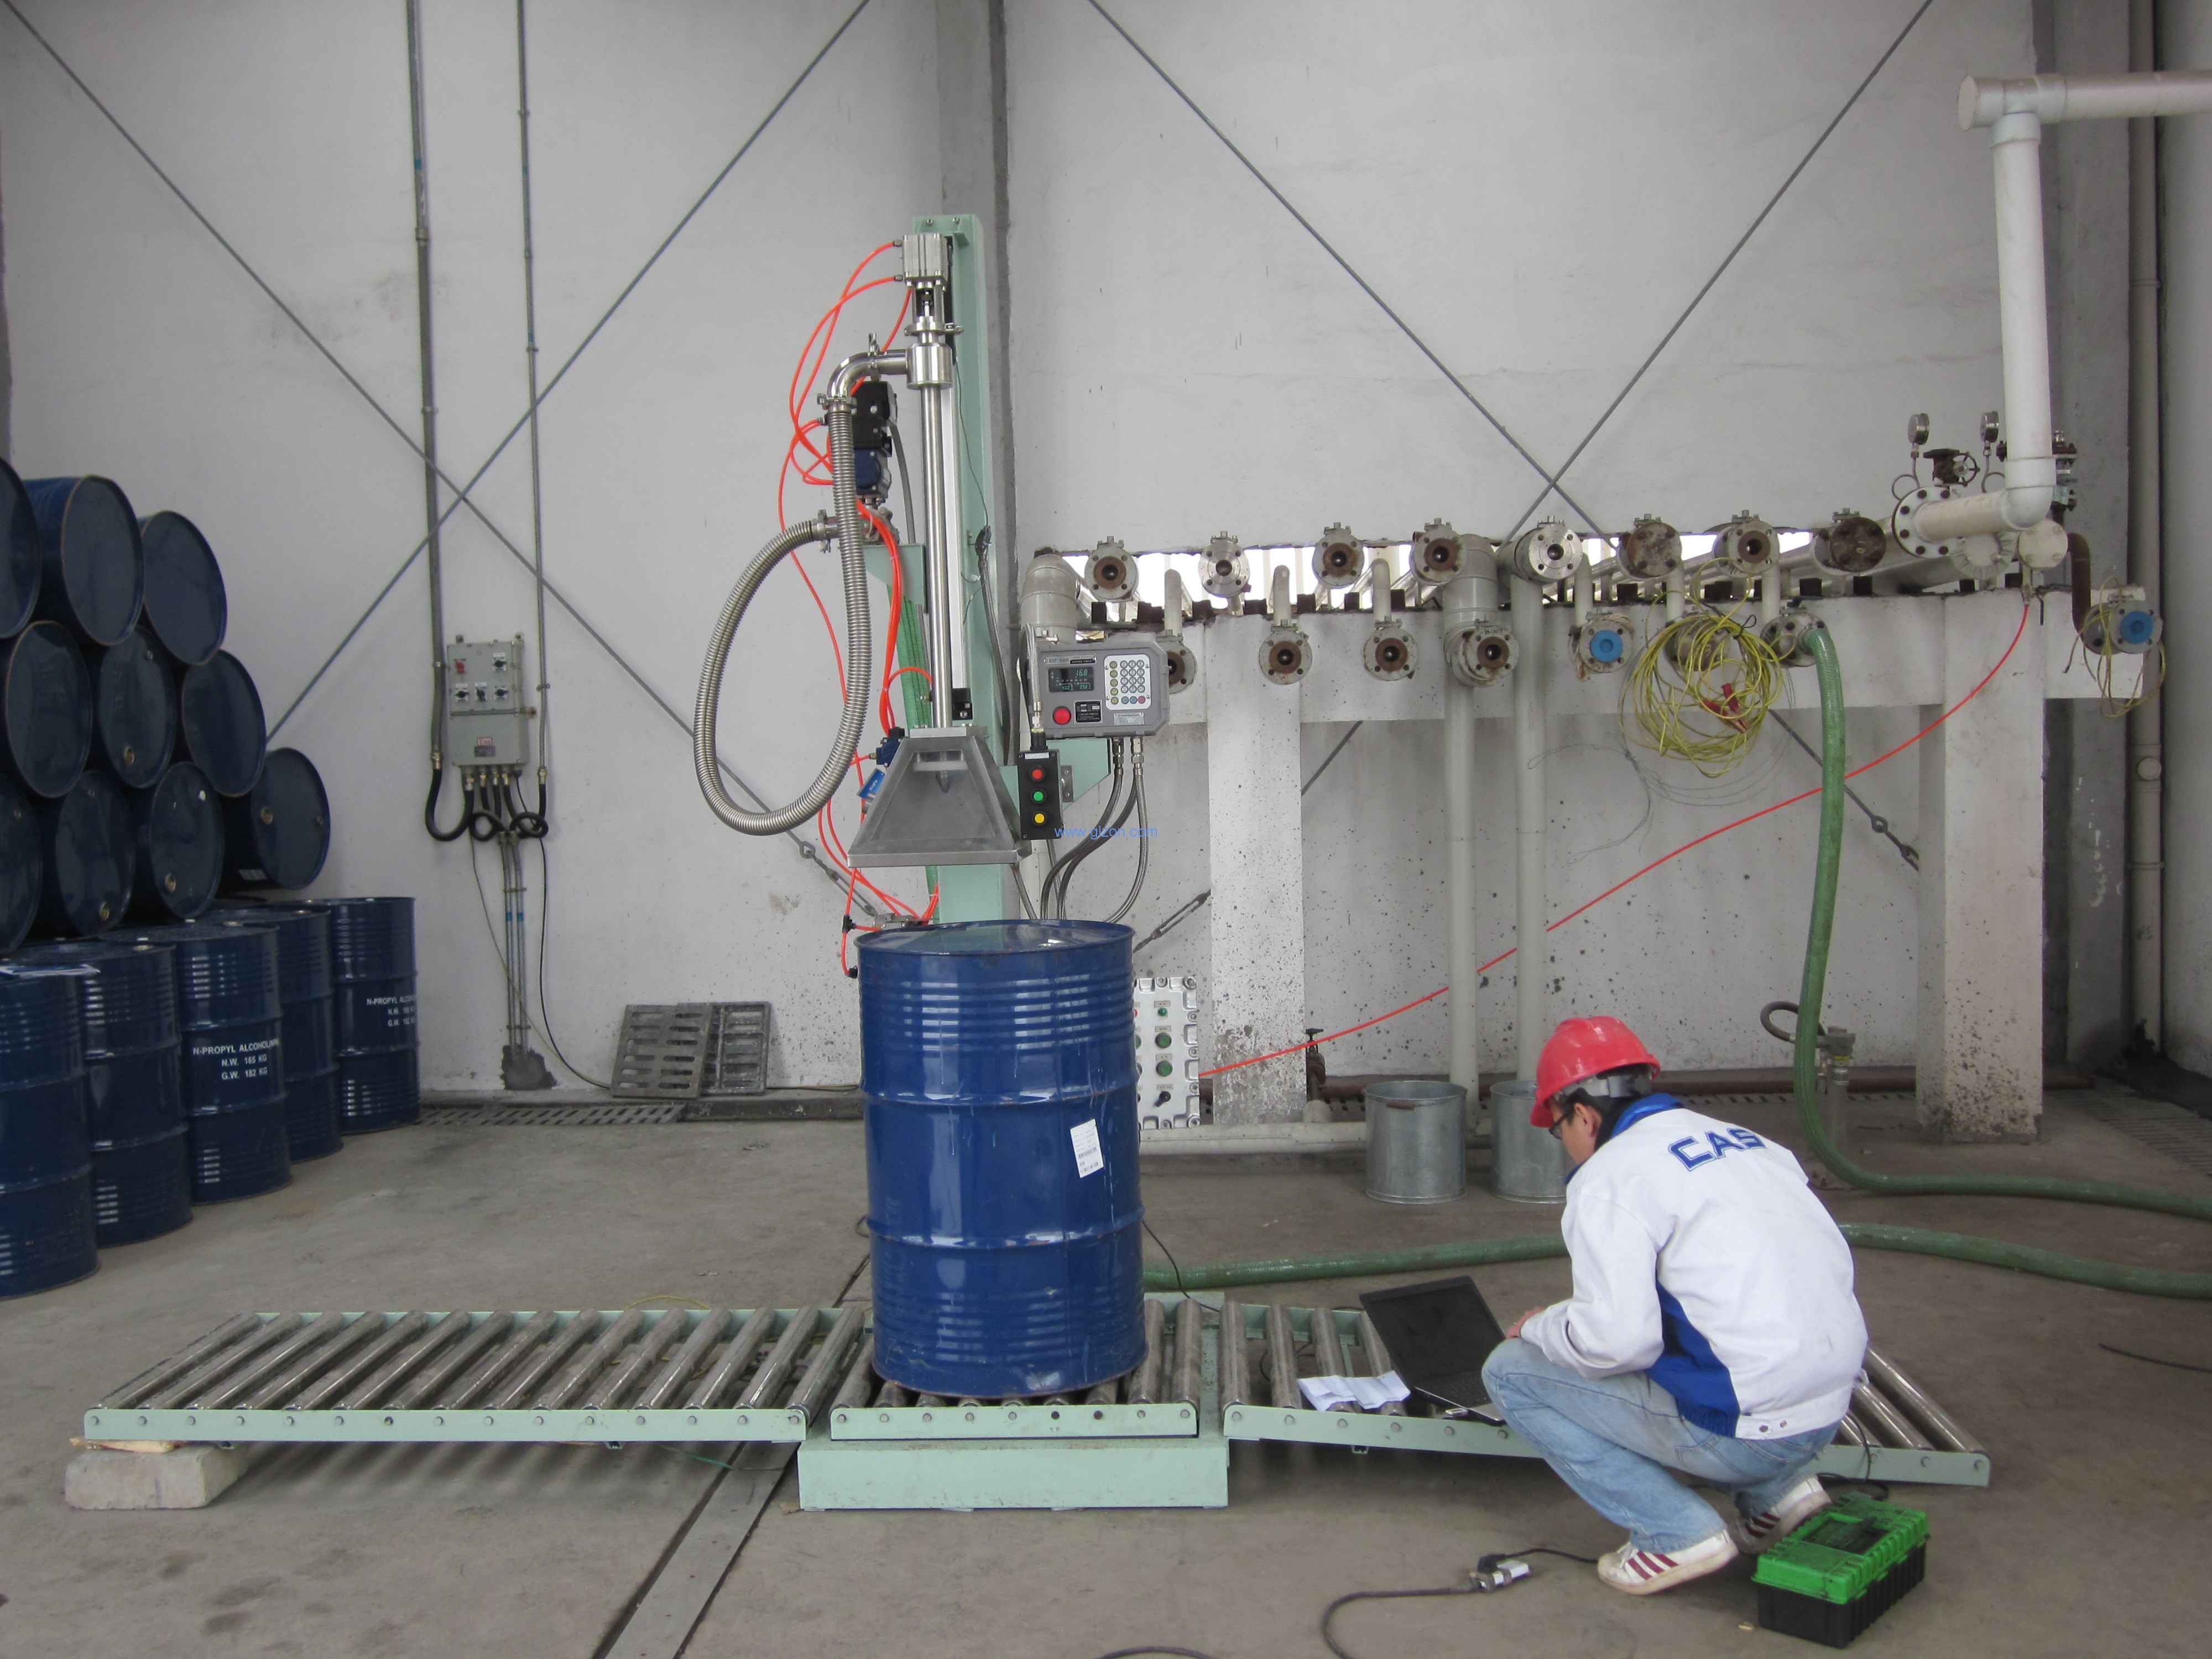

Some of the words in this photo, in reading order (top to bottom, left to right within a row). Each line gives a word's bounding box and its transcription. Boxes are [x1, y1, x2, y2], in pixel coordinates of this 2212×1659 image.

[367, 997, 397, 1005] N-PROPYL
[193, 1045, 236, 1055] N-PROPYL
[222, 1058, 239, 1067] N.W.
[244, 1056, 256, 1065] 165
[258, 1053, 268, 1063] KG
[222, 1071, 239, 1080] G.W.
[244, 1068, 257, 1077] 182
[259, 1067, 268, 1076] KG
[1668, 1128, 1766, 1172] CAS
